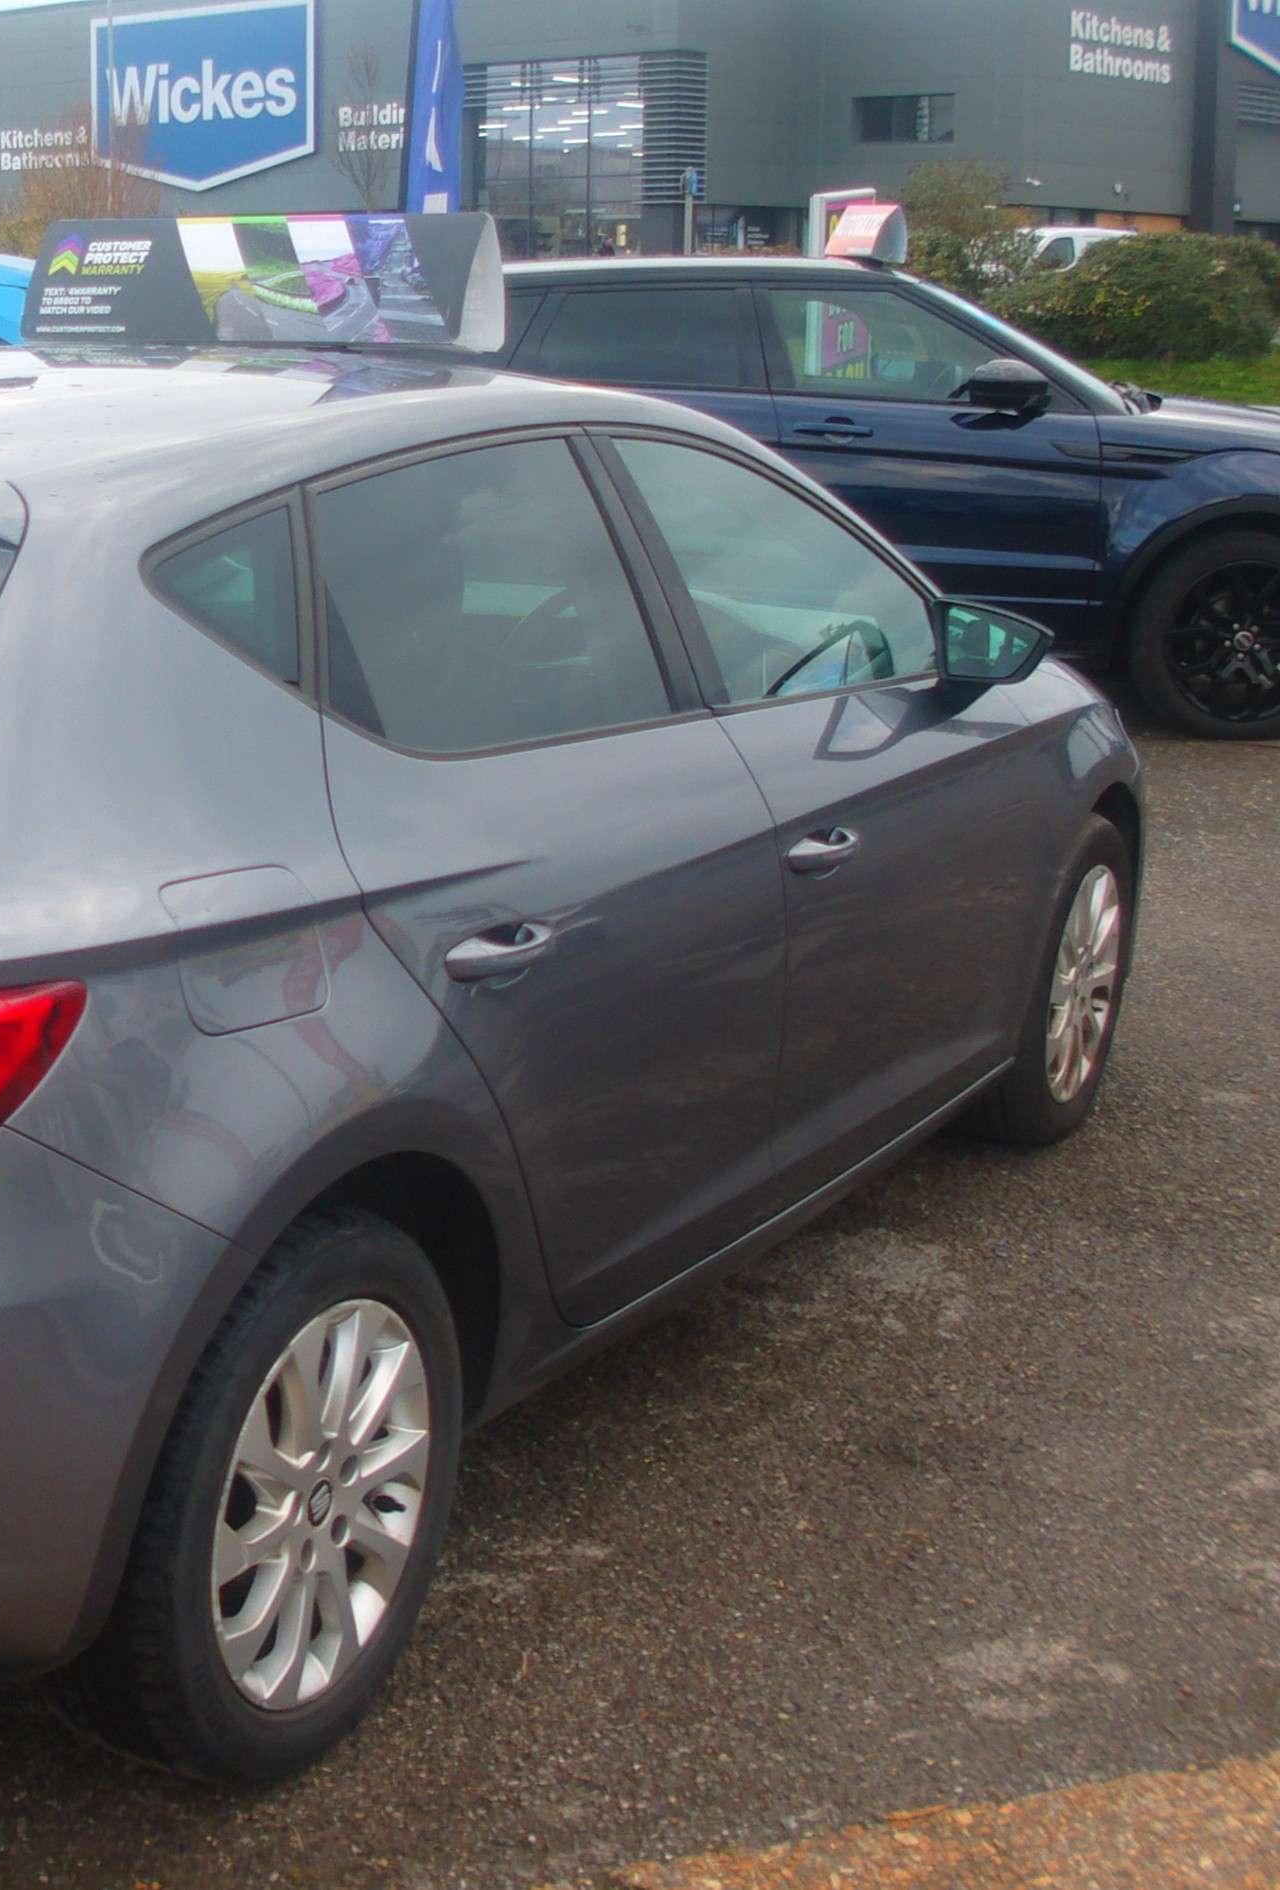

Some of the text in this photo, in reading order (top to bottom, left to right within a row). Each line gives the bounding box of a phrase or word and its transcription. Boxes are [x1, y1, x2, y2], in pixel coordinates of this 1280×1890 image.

[1070, 10, 1171, 52] Kitchens &
[1070, 43, 1170, 84] Bathrooms
[105, 58, 297, 127] Wickes
[0, 125, 88, 149] Kitchens &
[89, 240, 152, 252] CUSTOMER
[81, 264, 144, 276] WARRANTY
[84, 252, 149, 265] PROTECT
